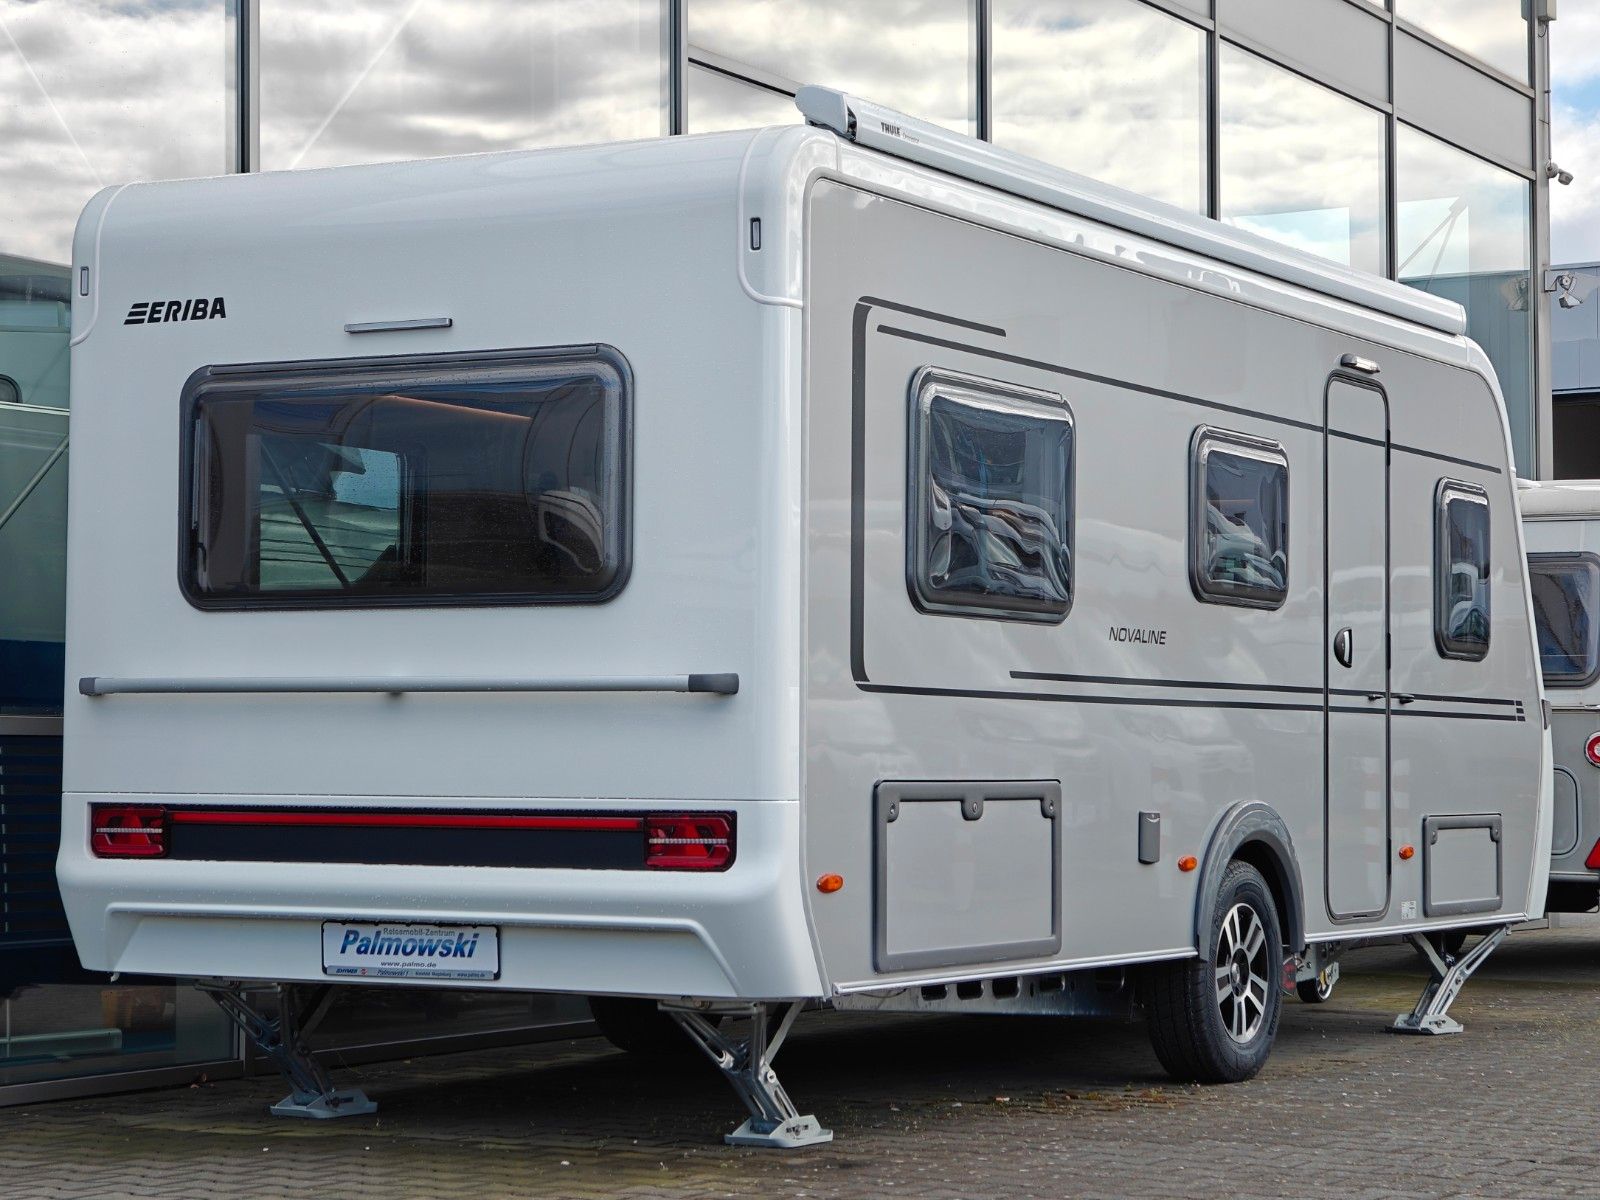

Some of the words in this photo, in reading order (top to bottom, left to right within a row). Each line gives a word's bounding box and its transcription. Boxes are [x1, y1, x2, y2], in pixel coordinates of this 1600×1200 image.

[880, 121, 901, 137] THULE
[146, 297, 227, 324] ERIBA
[1109, 626, 1167, 645] NOVALINE
[340, 929, 480, 958] Palmowski
[380, 961, 437, 969] www.palmo.de
